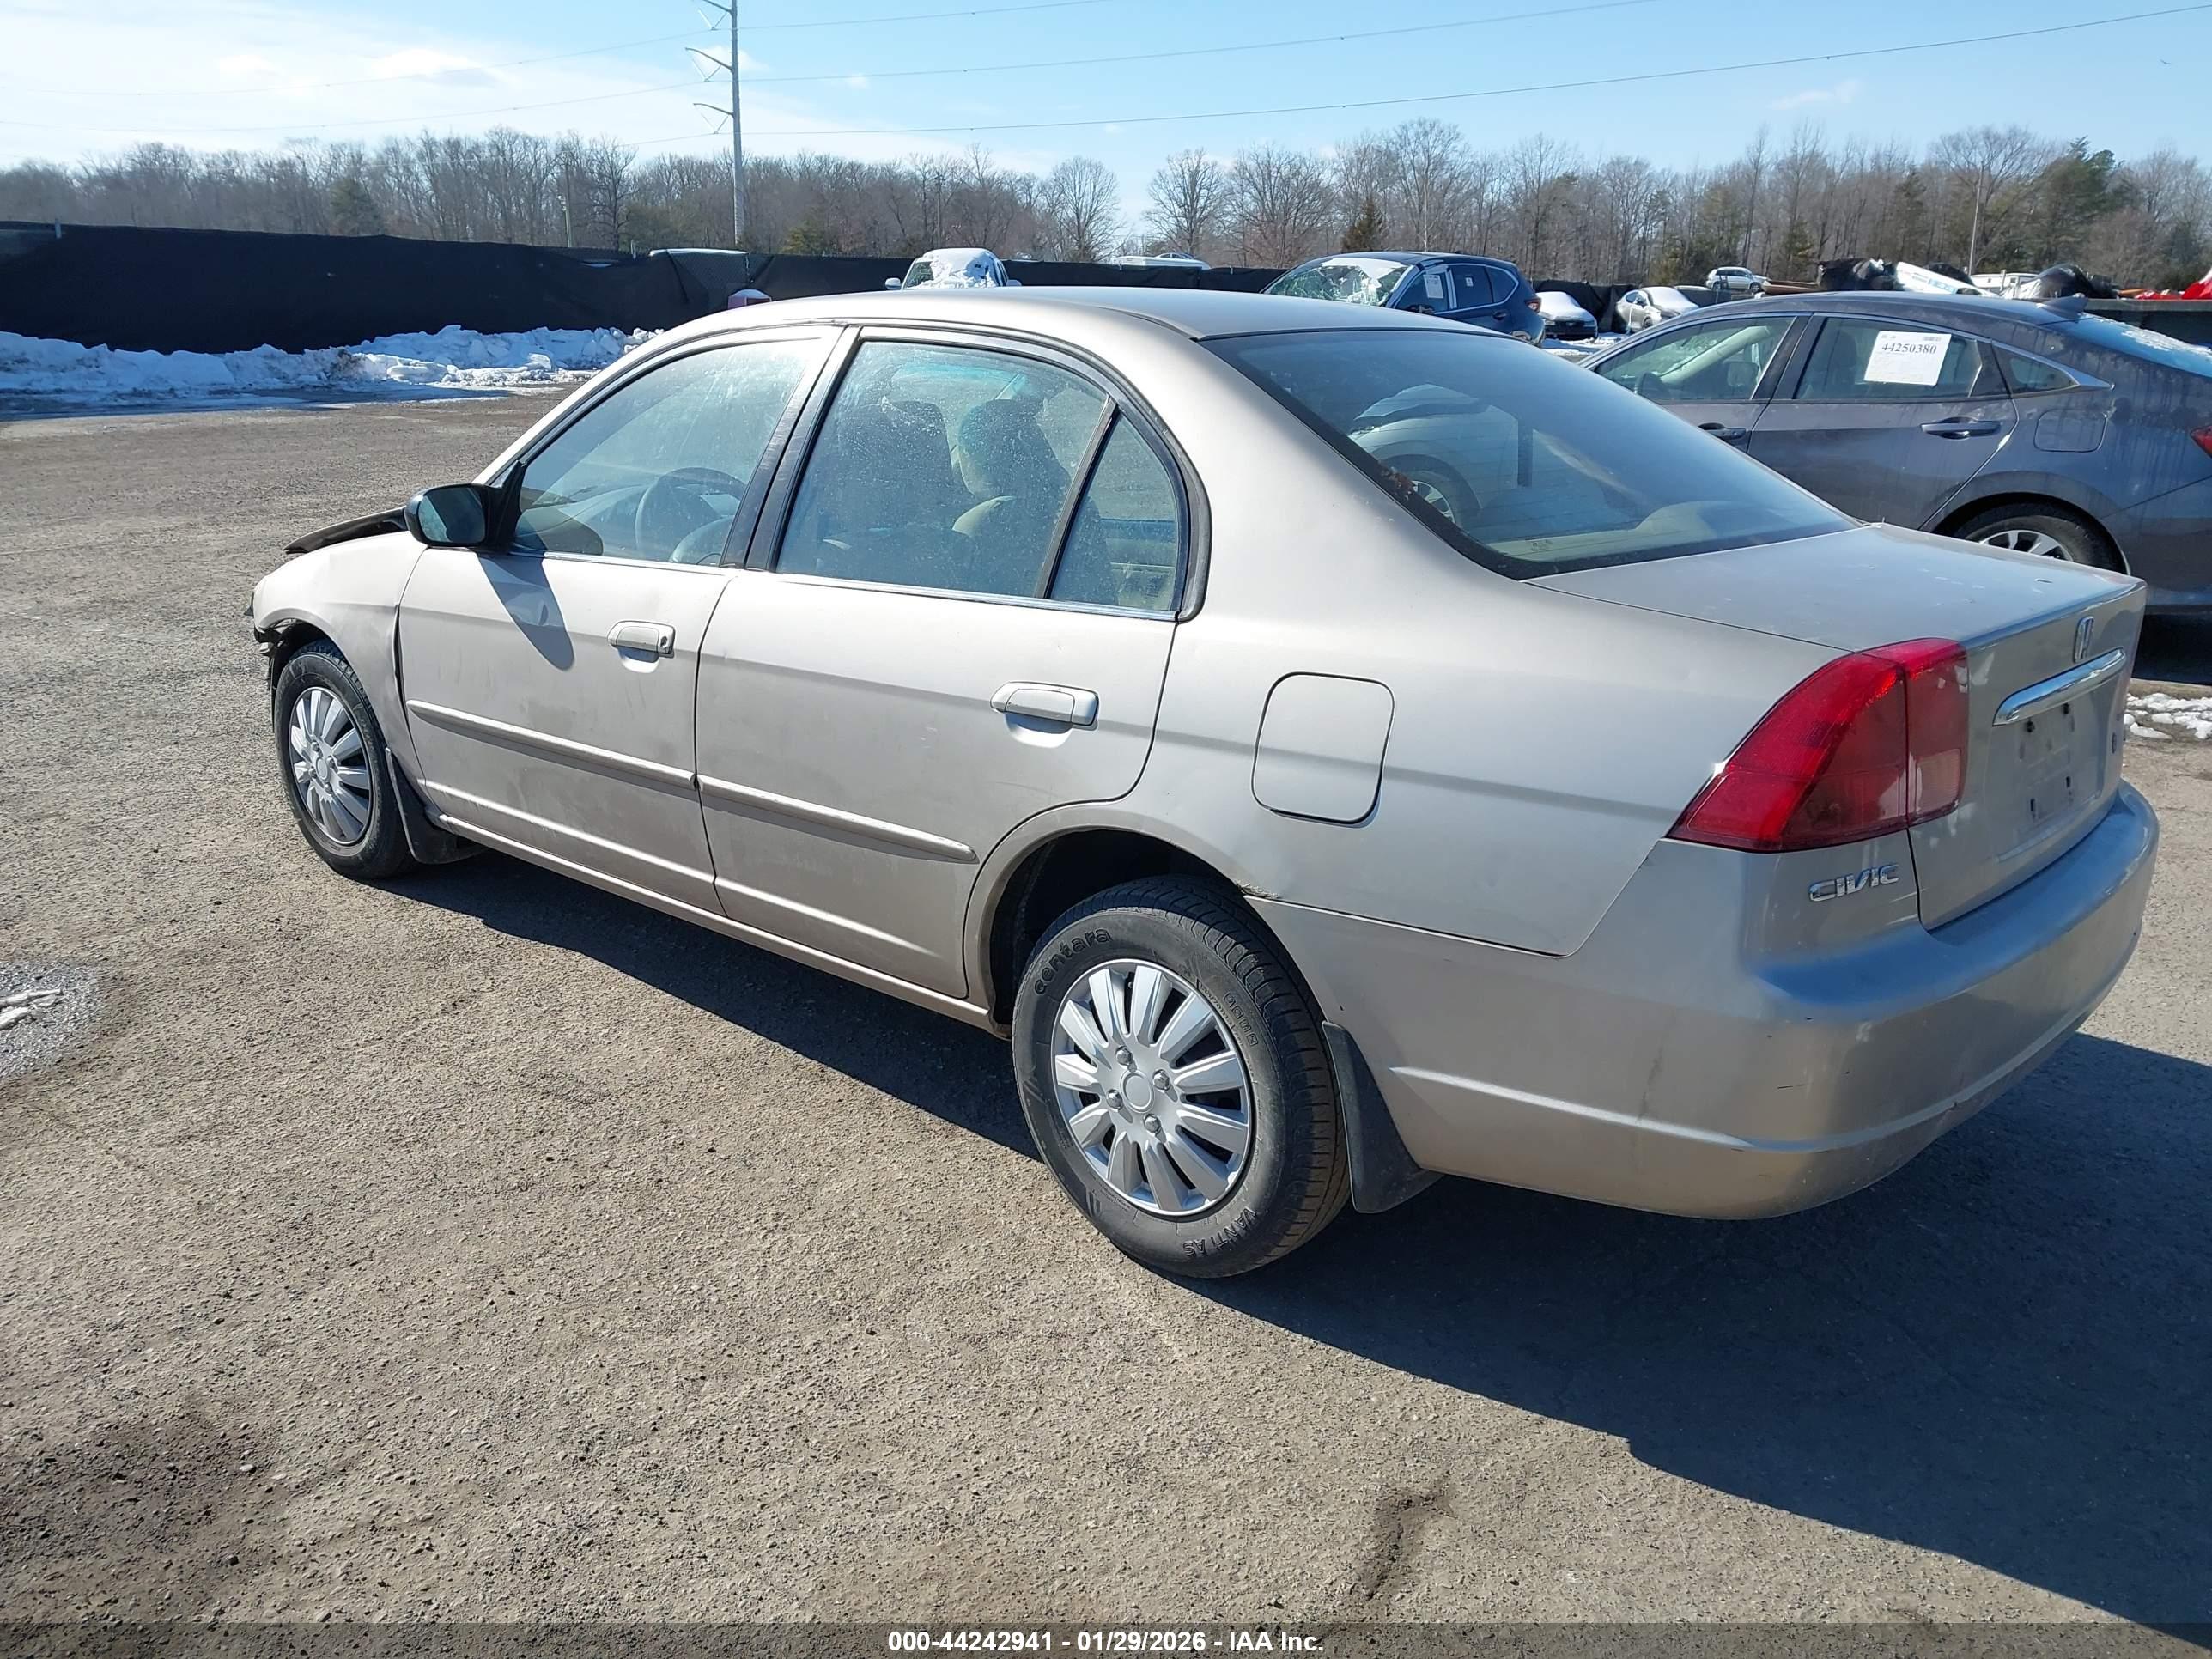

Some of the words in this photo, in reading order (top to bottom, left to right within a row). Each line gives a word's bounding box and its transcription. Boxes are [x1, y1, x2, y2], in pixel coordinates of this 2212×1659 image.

[1881, 343, 1937, 355] 44250380
[1808, 863, 1899, 902] CIVIC
[1209, 1206, 1257, 1250] VANTI
[1182, 1237, 1208, 1257] AS
